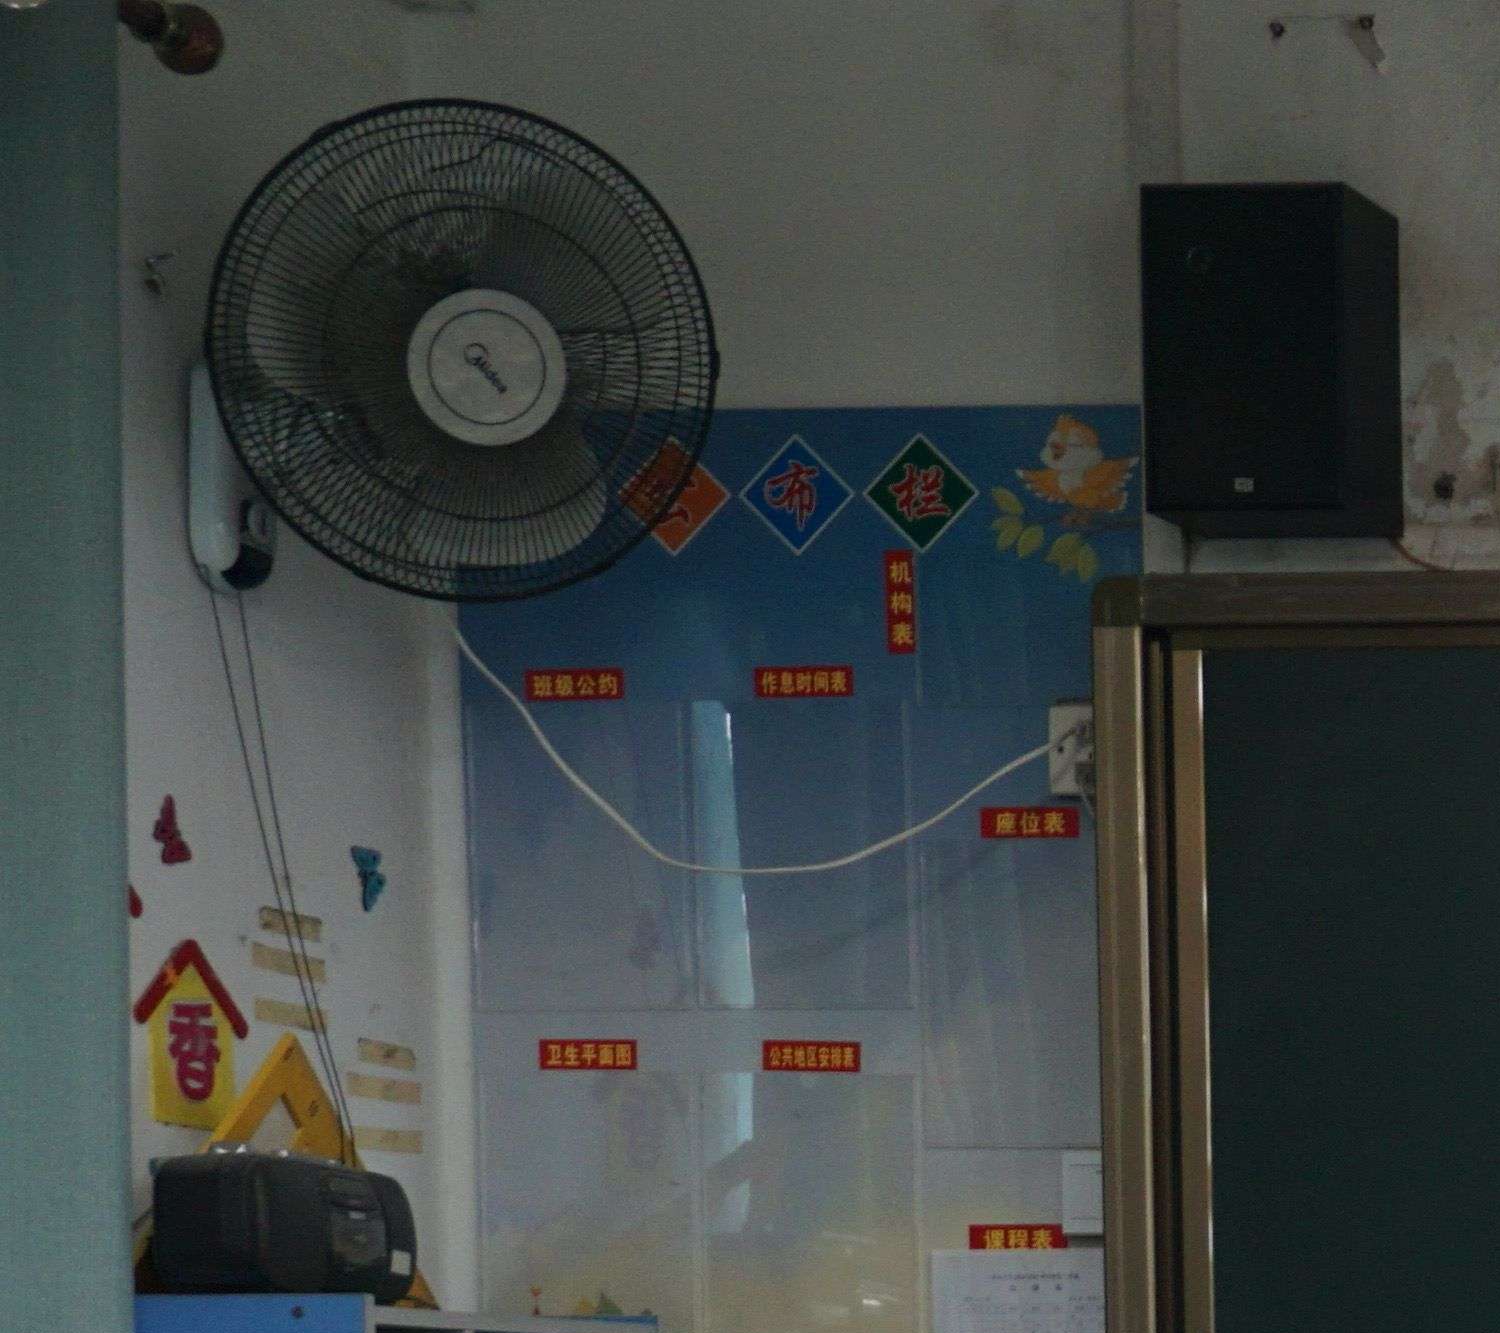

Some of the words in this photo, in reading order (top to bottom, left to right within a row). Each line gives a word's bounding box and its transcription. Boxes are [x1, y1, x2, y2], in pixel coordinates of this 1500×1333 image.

[533, 672, 618, 697] 班级公约
[761, 670, 848, 694] 作息时间表
[995, 811, 1064, 835] 座位表
[546, 1043, 632, 1066] 卫生平面图
